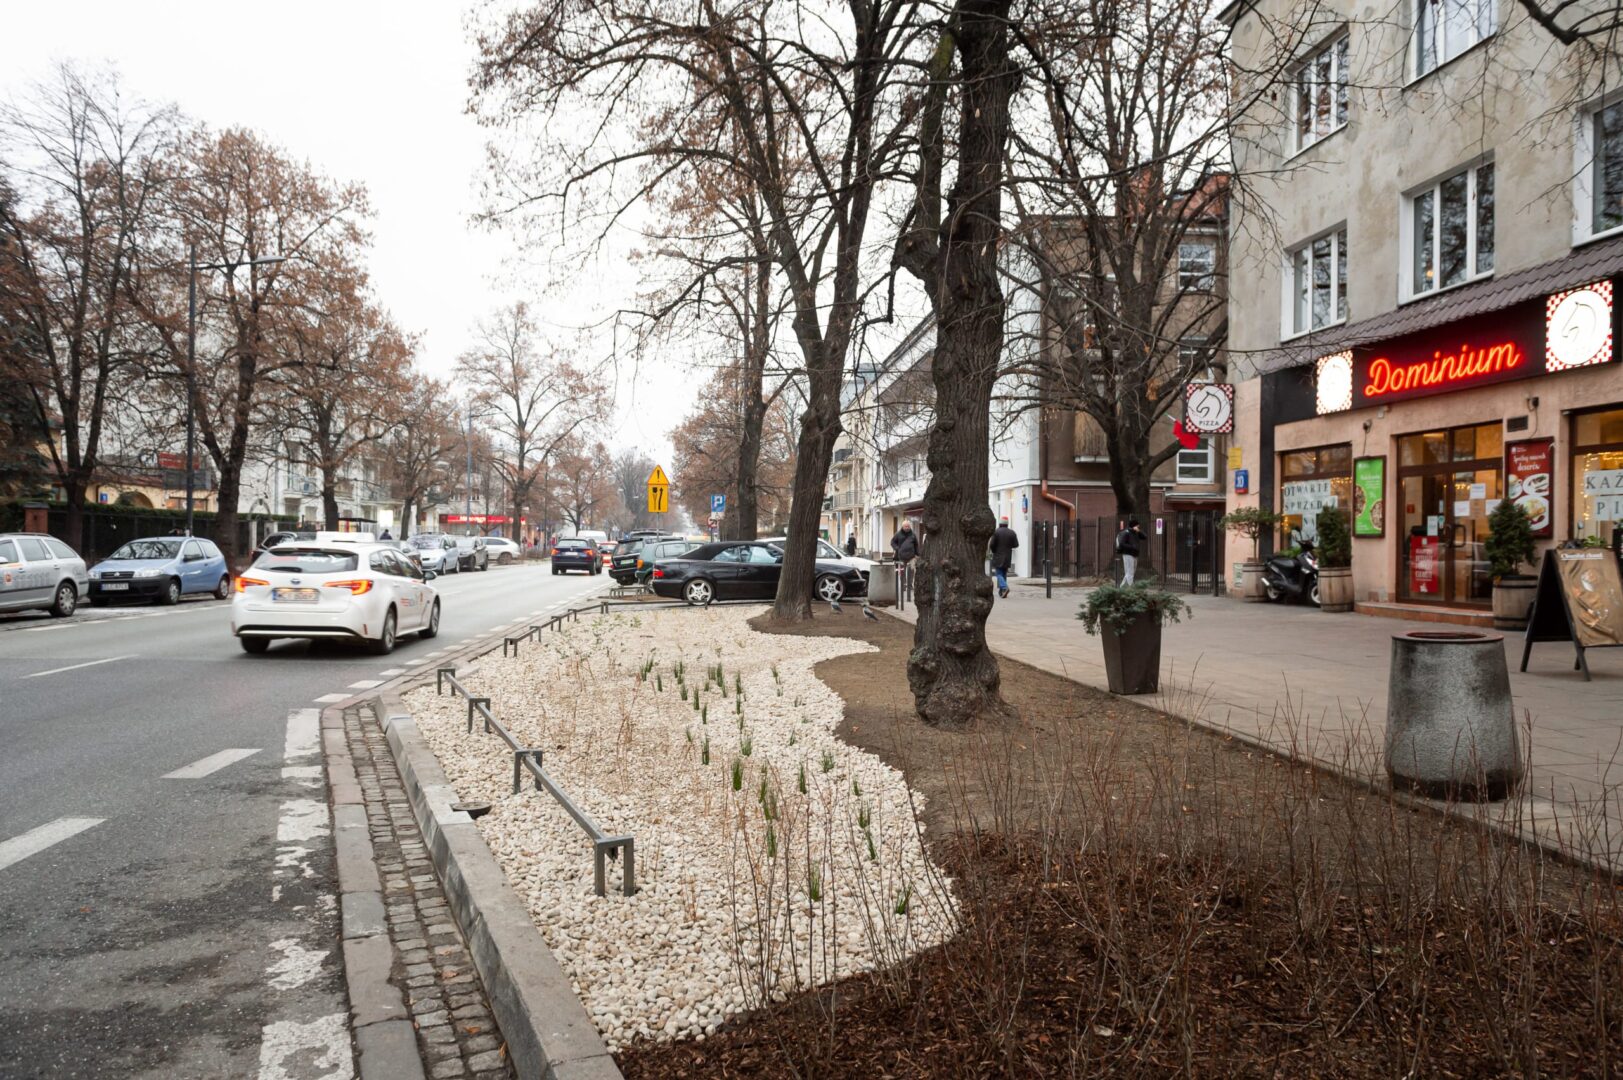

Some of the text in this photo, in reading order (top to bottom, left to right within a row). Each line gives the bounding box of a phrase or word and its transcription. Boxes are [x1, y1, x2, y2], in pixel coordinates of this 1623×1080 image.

[1364, 343, 1521, 396] Dominium
[1284, 482, 1329, 497] OTWARTE
[1597, 501, 1623, 515] PI
